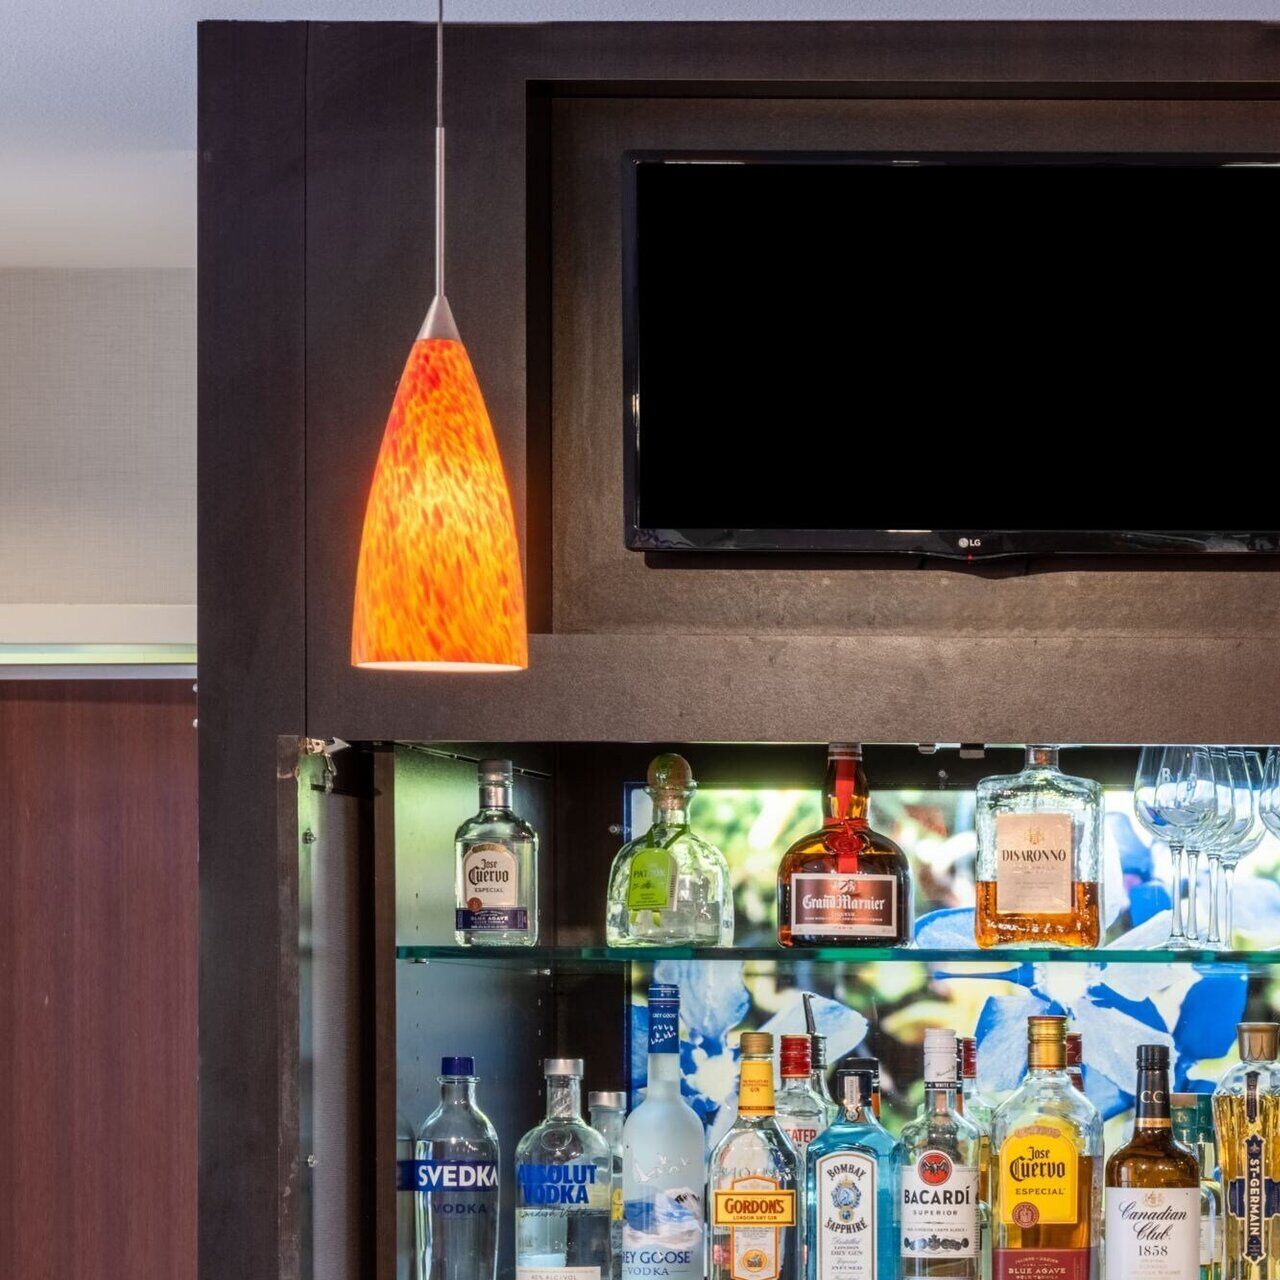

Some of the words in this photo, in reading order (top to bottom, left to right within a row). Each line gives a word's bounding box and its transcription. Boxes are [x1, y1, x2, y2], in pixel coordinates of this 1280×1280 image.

[969, 539, 981, 547] LG
[481, 858, 497, 870] Jose
[1002, 849, 1067, 862] DISARONNO
[468, 866, 509, 886] Cuervo
[802, 894, 836, 910] Grand
[837, 895, 885, 911] Marnier
[1028, 1146, 1050, 1162] Jose
[517, 1164, 597, 1184] ABSOLUT
[826, 1163, 867, 1182] BOMBAY
[1009, 1156, 1066, 1182] Cuervo
[523, 1184, 590, 1204] VODKA
[904, 1186, 970, 1205] BACARDÍ
[1015, 1188, 1065, 1196] ESPECIAL
[1249, 1158, 1260, 1237] ST-GERMAIN
[432, 1204, 488, 1214] VODKA
[724, 1198, 785, 1215] GORDON'S
[1118, 1200, 1187, 1221] Canadian
[824, 1217, 868, 1234] SAPPHIRE
[640, 1251, 691, 1264] GOOSE
[1137, 1244, 1169, 1257] 1858
[627, 1267, 669, 1276] VODKA
